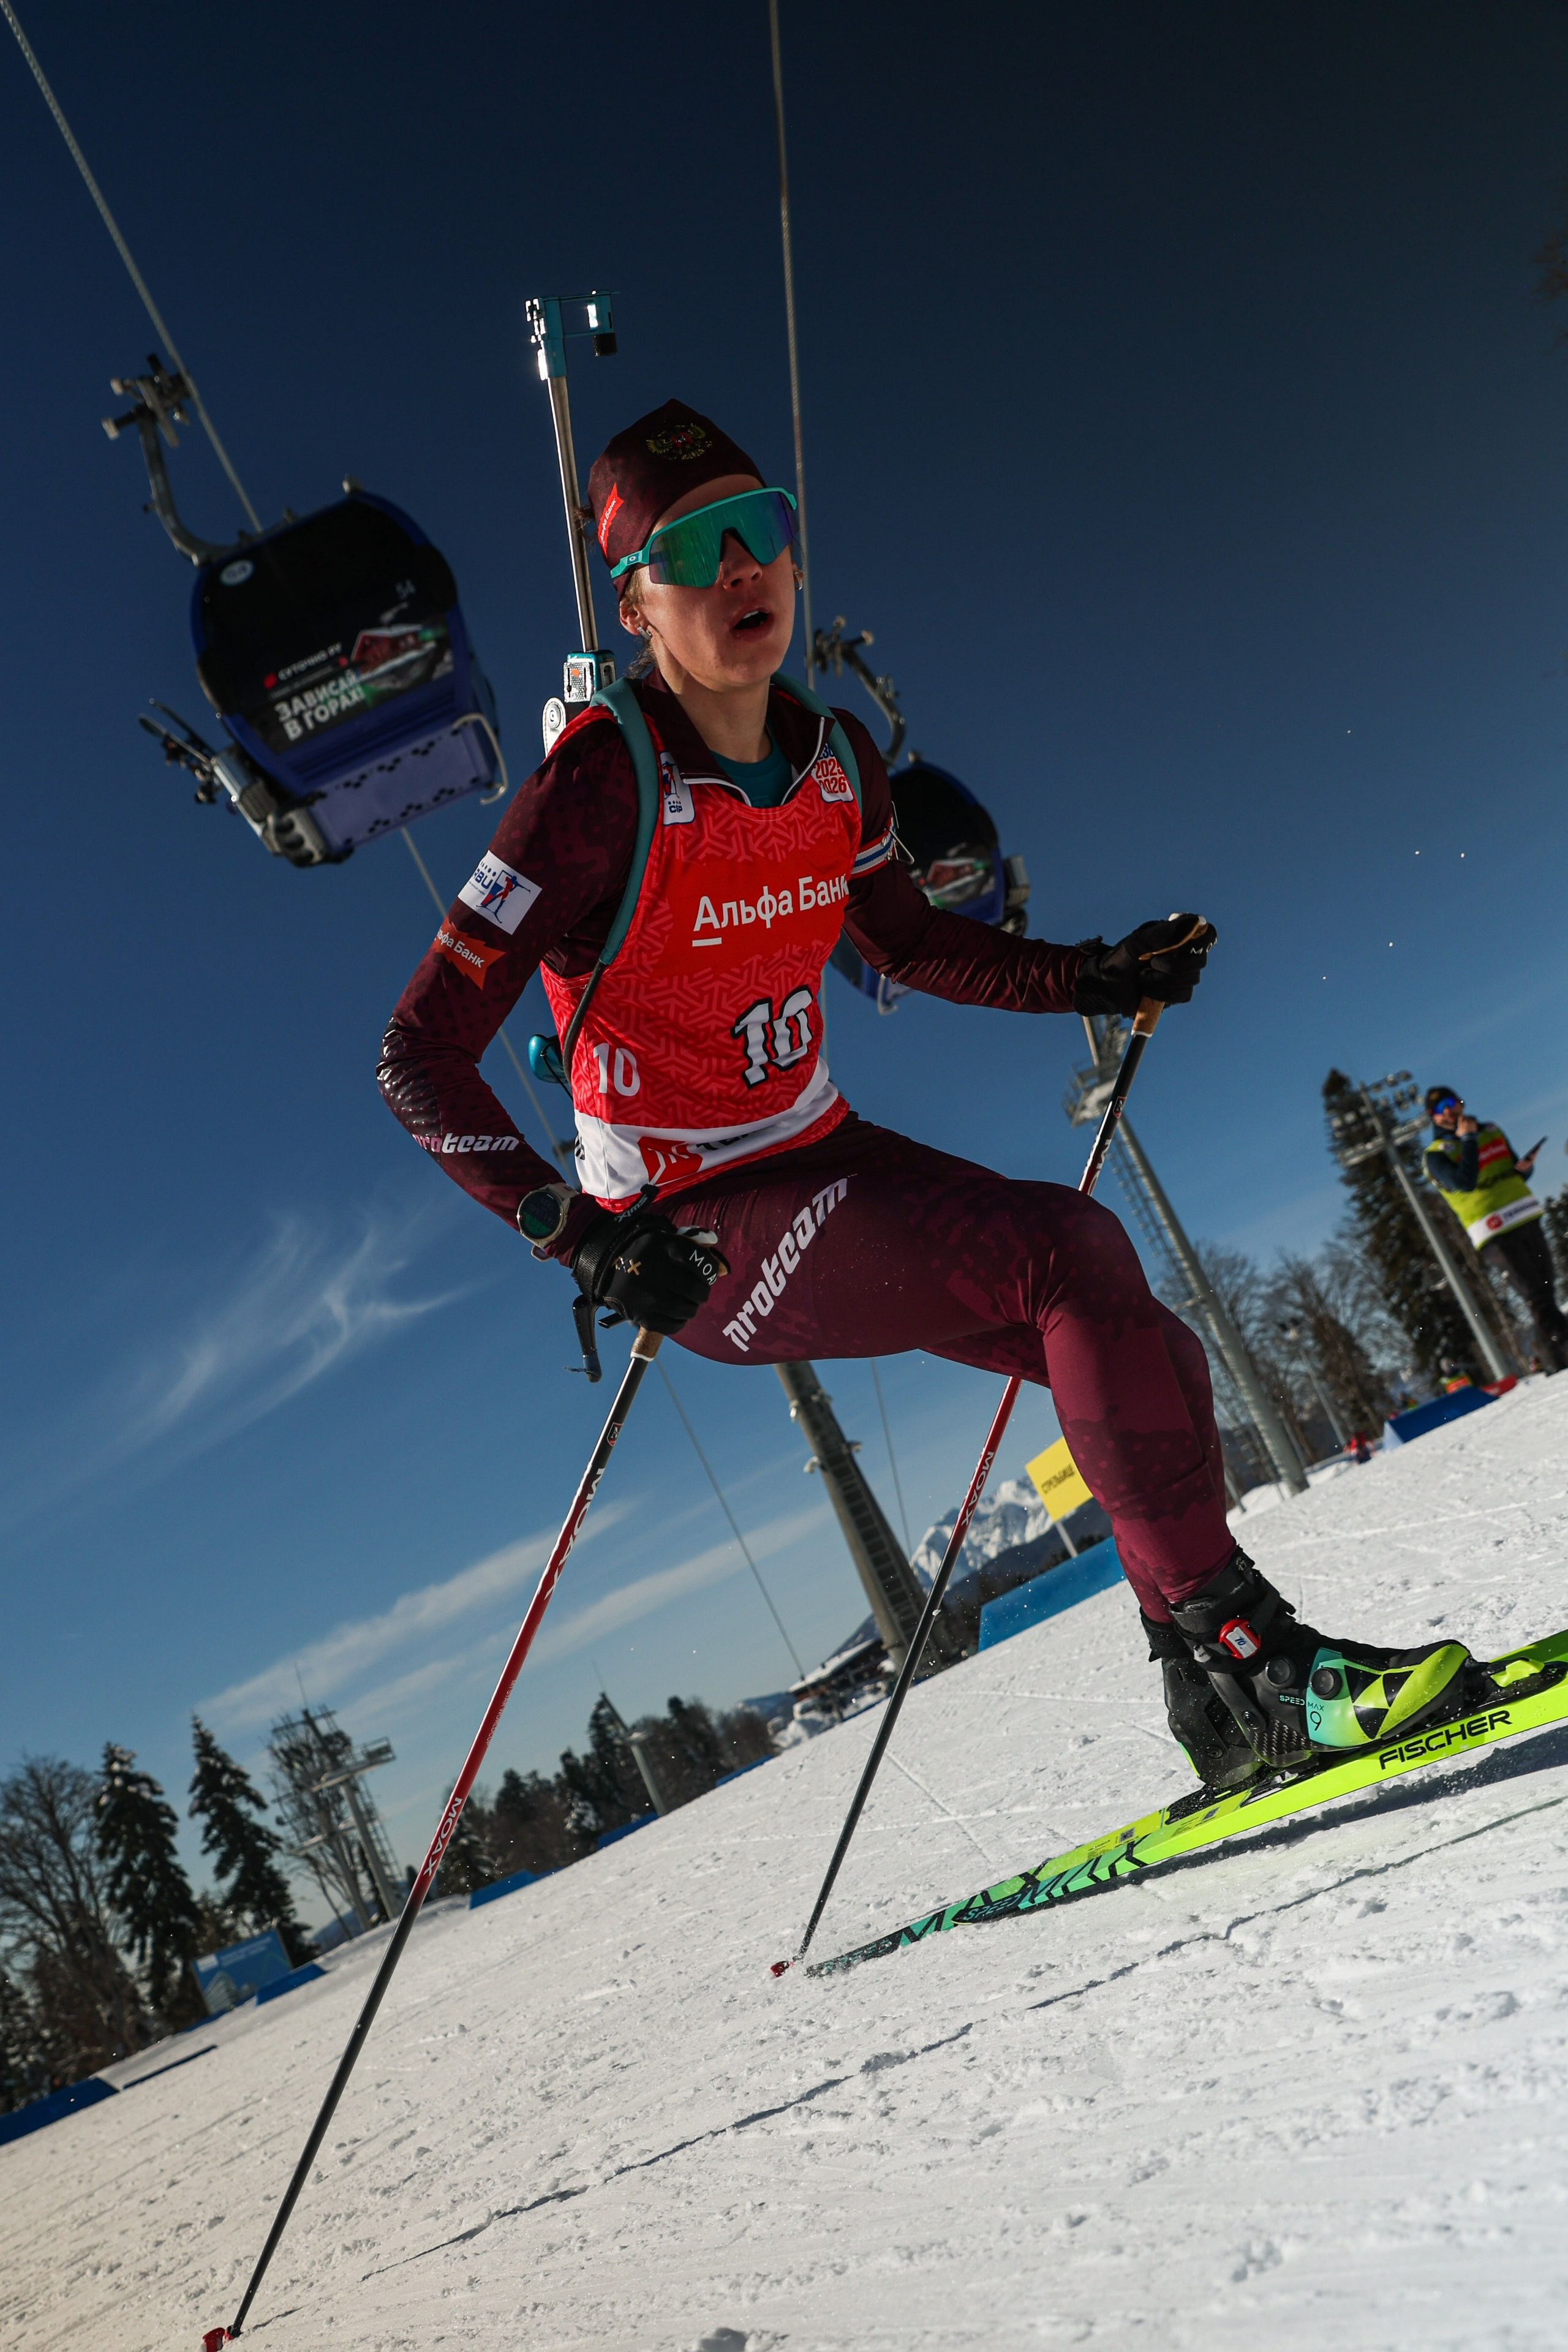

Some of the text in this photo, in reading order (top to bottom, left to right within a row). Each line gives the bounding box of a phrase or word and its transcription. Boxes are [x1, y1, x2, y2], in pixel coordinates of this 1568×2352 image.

[605, 498, 617, 519] Банк
[274, 669, 360, 722] ЗАВИСАЙ
[282, 687, 367, 741] В ГОРАХ!
[693, 873, 849, 931] Альфа Банк
[437, 924, 486, 968] льфа Банк
[731, 984, 814, 1089] 10
[593, 1042, 641, 1096] 10
[413, 1131, 519, 1154] proteam
[723, 1177, 848, 1352] proteam
[960, 1451, 993, 1526] MOAX
[1279, 1695, 1324, 1712] SPEED MAX
[1310, 1711, 1322, 1731] 9
[1379, 1709, 1512, 1770] FISCHER
[423, 1796, 463, 1876] MOAX
[963, 1894, 1021, 1921] SPEED
